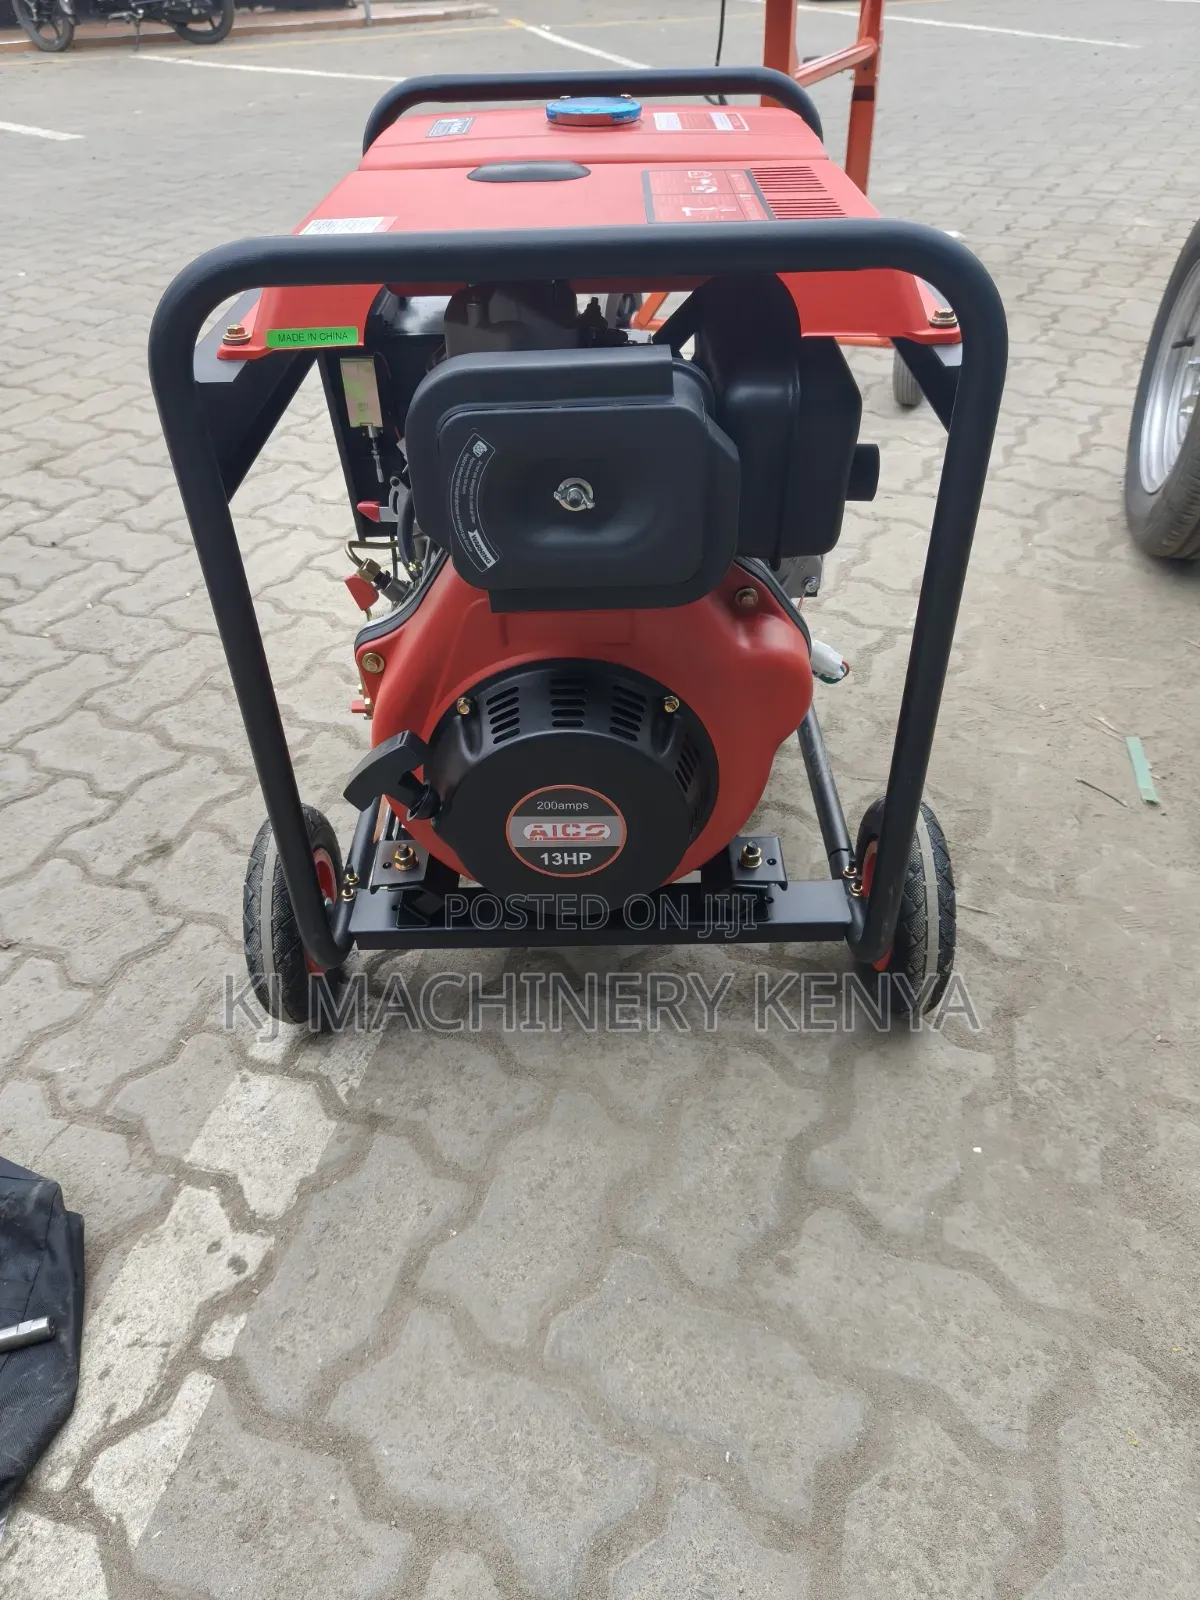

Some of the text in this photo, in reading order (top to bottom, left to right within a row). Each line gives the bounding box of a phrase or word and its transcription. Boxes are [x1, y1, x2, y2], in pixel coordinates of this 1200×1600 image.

[278, 331, 349, 343] MADE IN CHINA
[471, 534, 493, 566] WARNING
[536, 800, 590, 812] 200amps
[540, 852, 592, 866] 13HP
